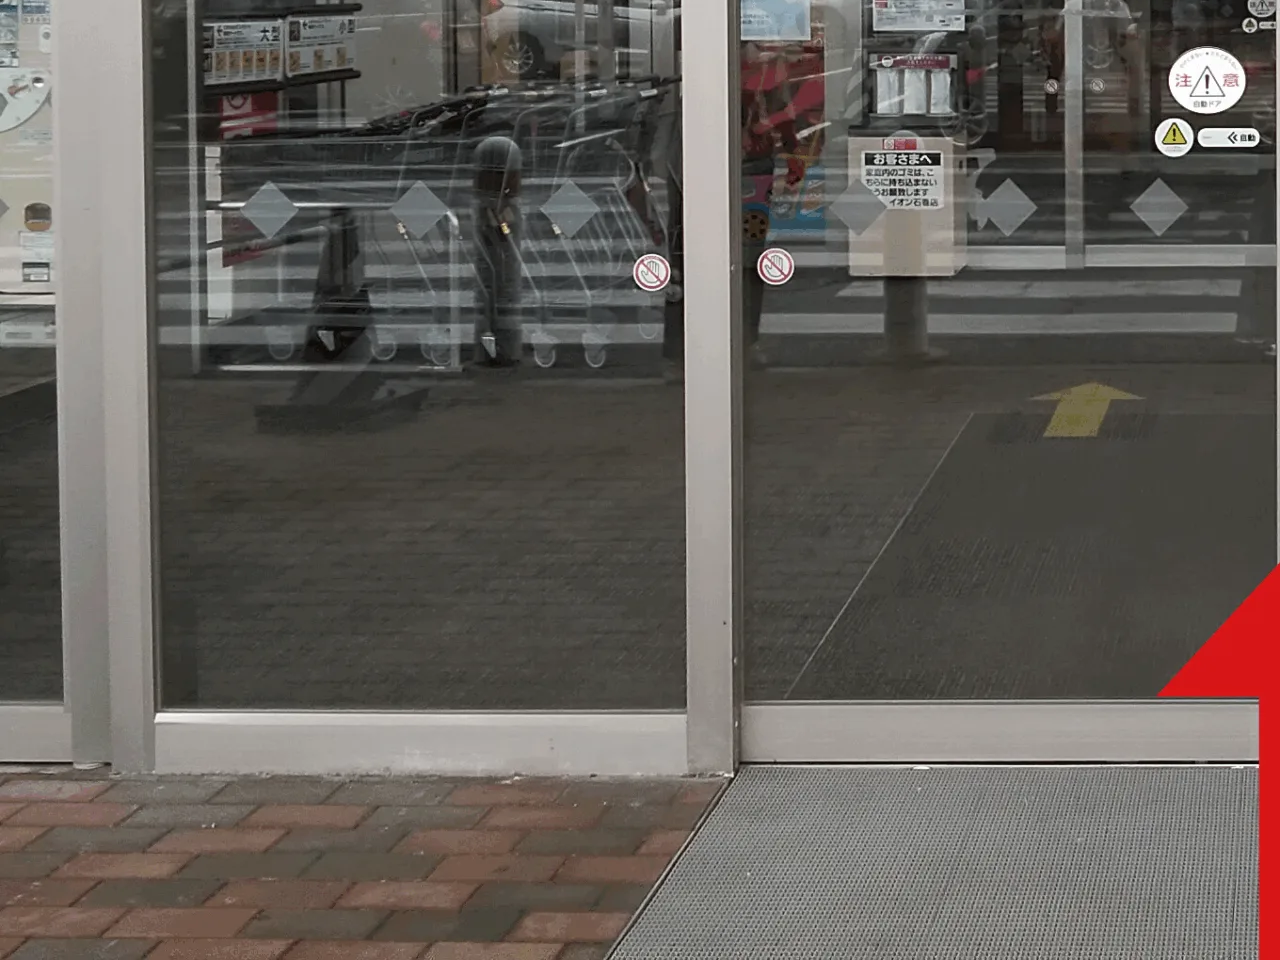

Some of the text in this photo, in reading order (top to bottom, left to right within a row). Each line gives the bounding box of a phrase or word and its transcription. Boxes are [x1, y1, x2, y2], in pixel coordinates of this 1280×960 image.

[1193, 100, 1222, 108] 自動ドア
[1240, 133, 1256, 142] 自動
[873, 153, 932, 165] お客さまへ
[873, 188, 929, 197] うお願致します
